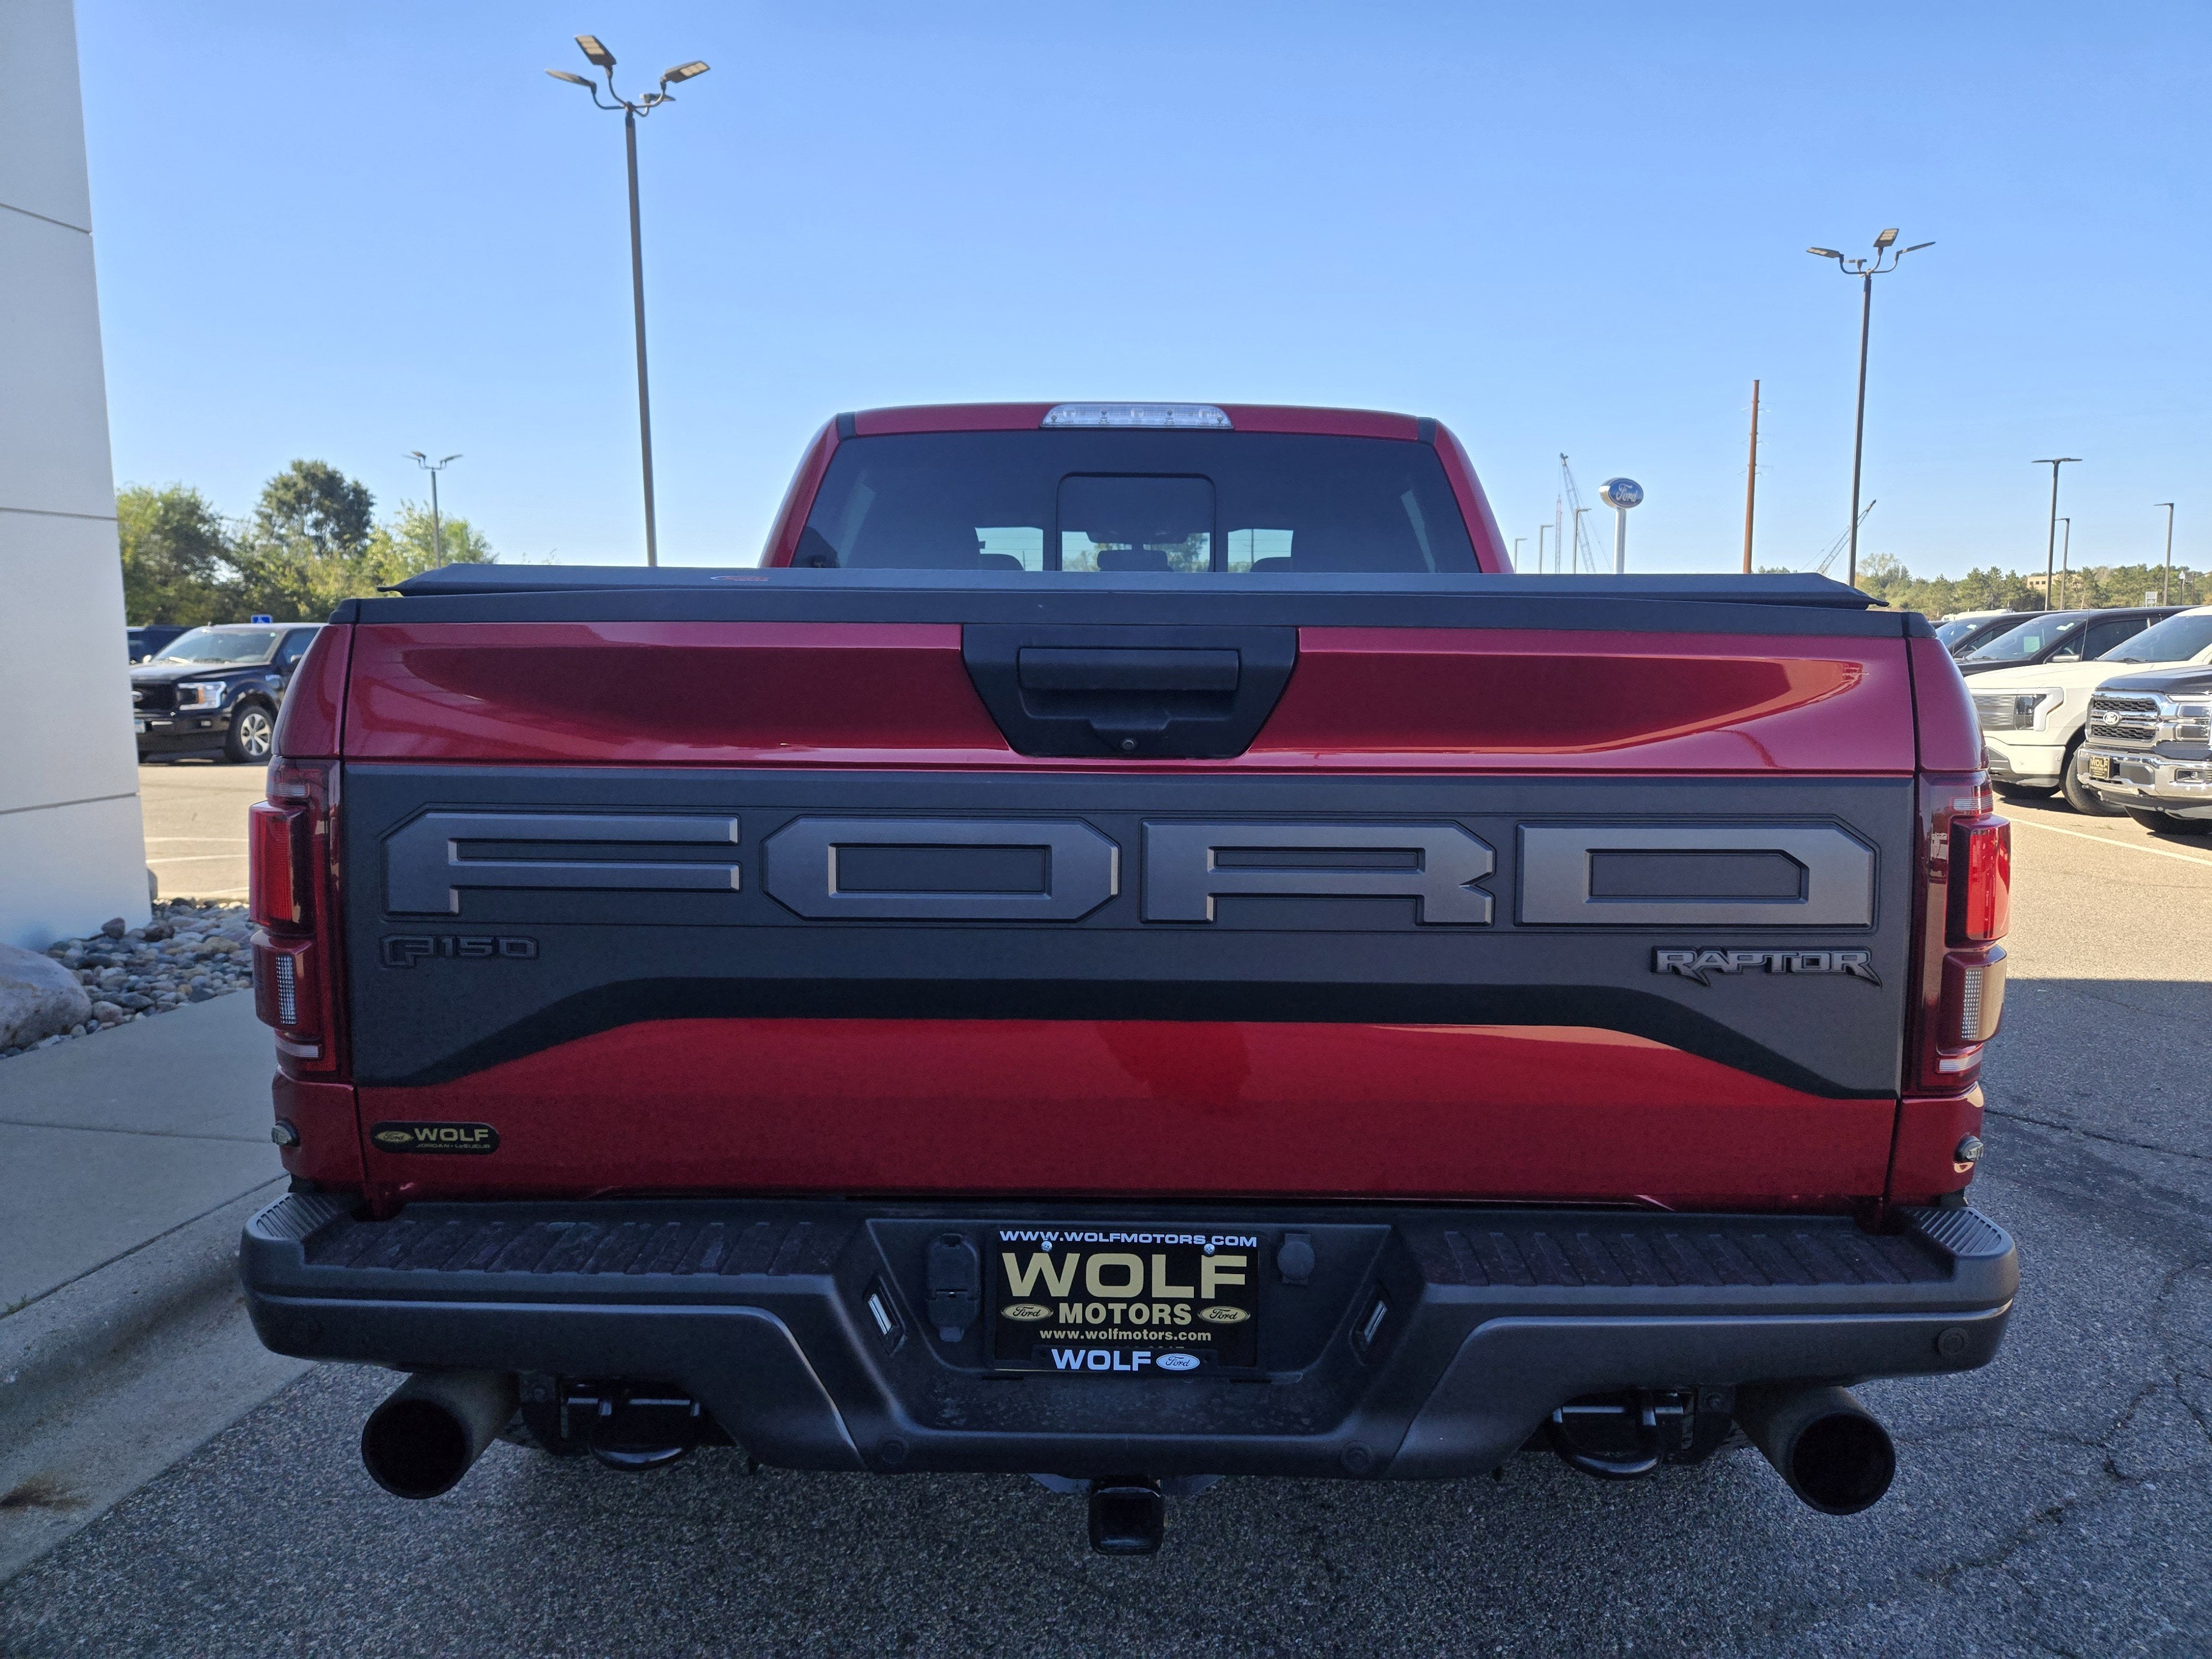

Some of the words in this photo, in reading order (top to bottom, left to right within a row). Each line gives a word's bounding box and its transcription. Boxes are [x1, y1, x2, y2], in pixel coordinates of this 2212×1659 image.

[1615, 483, 1637, 502] Ford
[382, 811, 1877, 929] FORD
[383, 935, 540, 966] F150
[1657, 949, 1882, 988] RAPTOR
[414, 1128, 489, 1142] WOLF
[999, 1231, 1257, 1248] WWW.WOLFMOTORSCOM
[1001, 1252, 1247, 1299] WOLF
[1013, 1306, 1041, 1317] Ford
[1059, 1302, 1192, 1325] MOTORS
[1209, 1308, 1238, 1320] Ford
[1040, 1328, 1212, 1341] www.wolfmotors.com
[1051, 1349, 1151, 1371] WOLF
[1165, 1356, 1191, 1367] Ford
